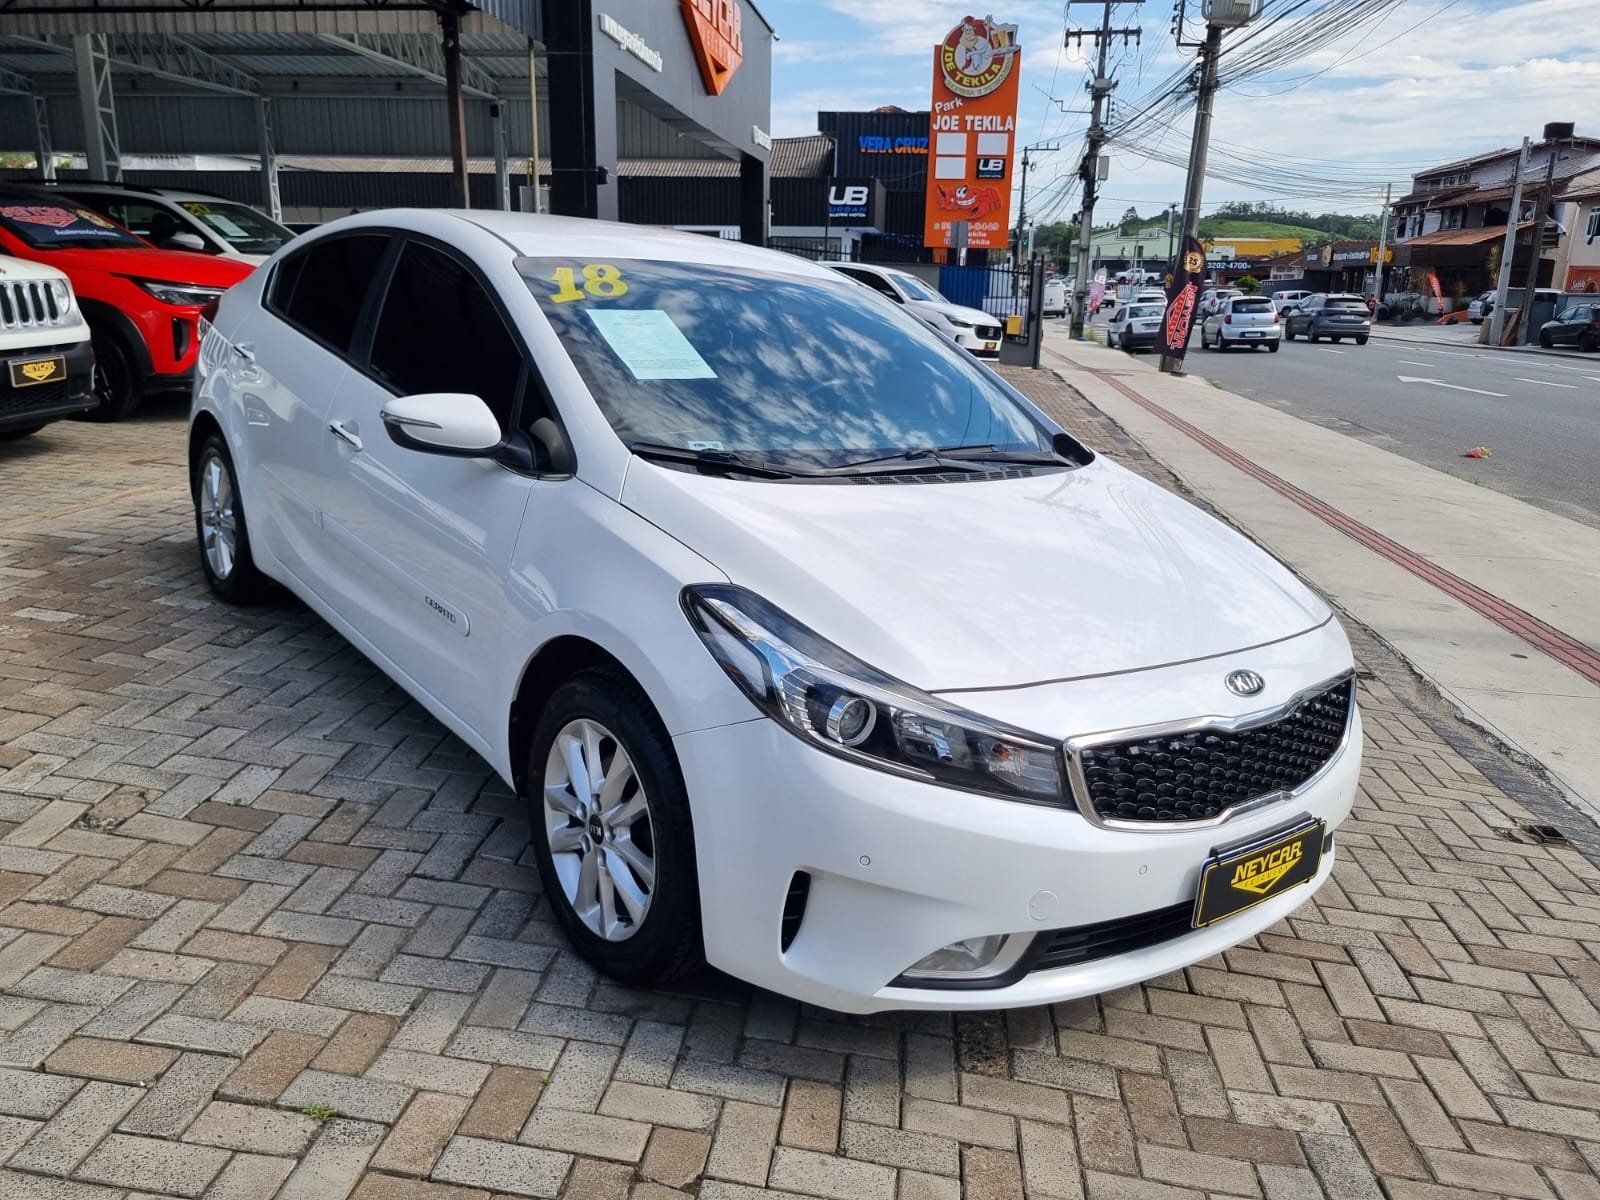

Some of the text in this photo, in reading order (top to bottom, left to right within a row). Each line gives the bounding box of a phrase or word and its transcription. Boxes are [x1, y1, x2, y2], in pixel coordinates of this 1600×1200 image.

[944, 44, 956, 72] JOE
[955, 63, 1001, 87] TEKILA
[934, 97, 964, 113] Park
[933, 115, 1014, 131] JOE TEKILA
[858, 136, 929, 154] VERA CRUZ
[978, 158, 1004, 171] UB
[828, 186, 869, 205] UB
[1188, 257, 1198, 266] 25
[549, 263, 628, 304] 18
[1169, 284, 1198, 350] NEYCAR
[22, 361, 56, 374] NEYCAR
[1231, 841, 1303, 885] NEYCAR
